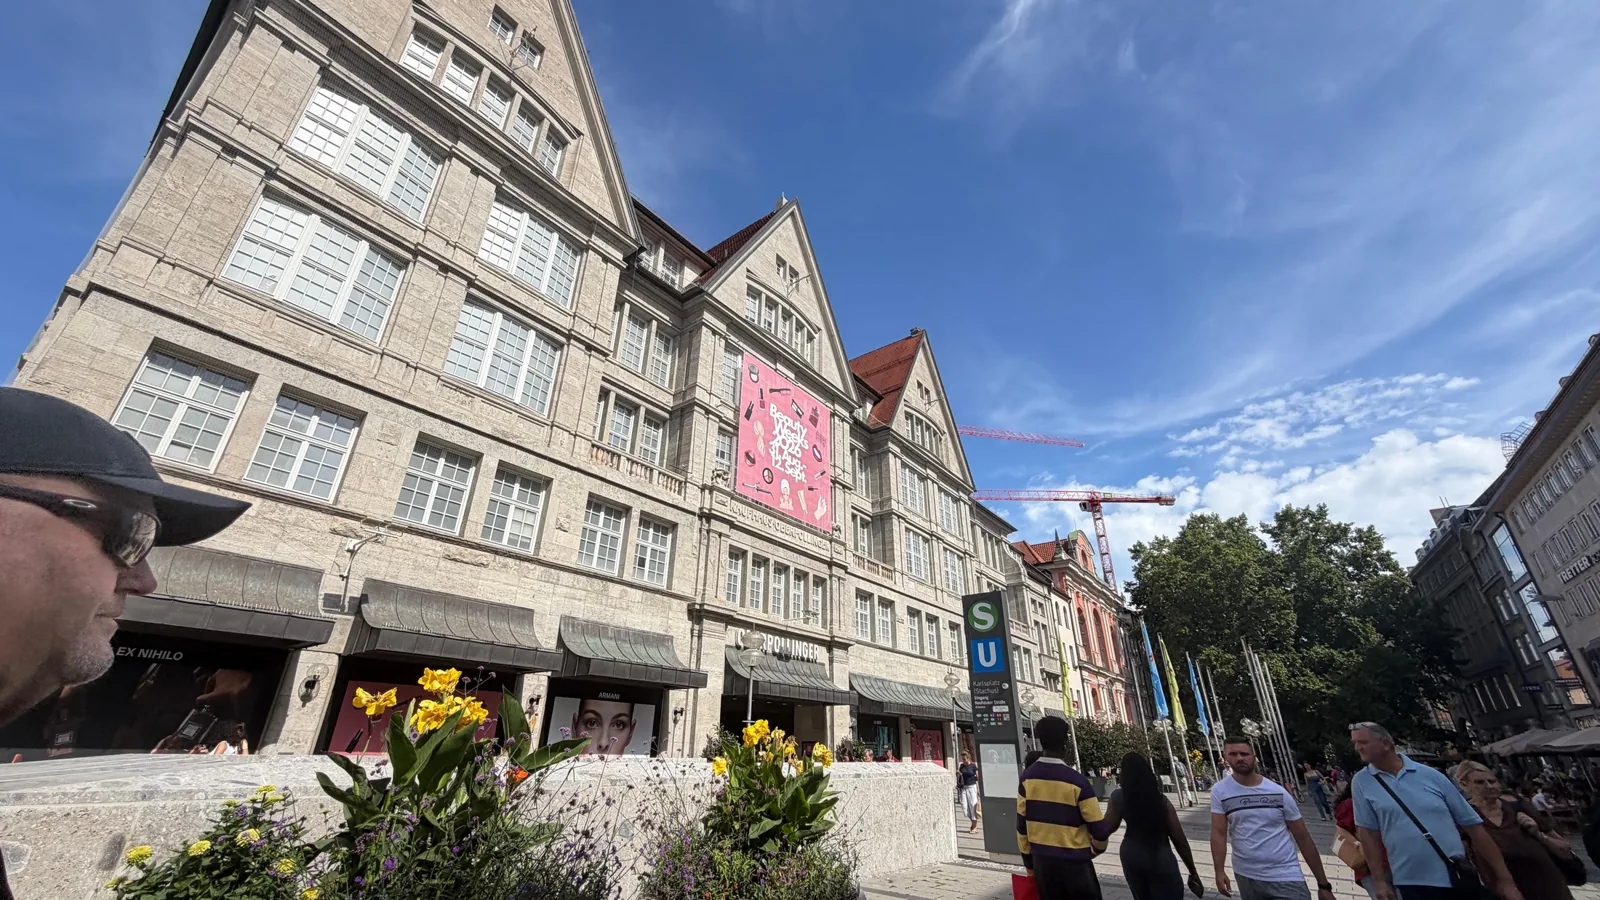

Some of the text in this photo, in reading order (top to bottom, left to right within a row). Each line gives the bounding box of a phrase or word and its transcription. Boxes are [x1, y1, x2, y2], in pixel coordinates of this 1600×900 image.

[769, 402, 808, 440] Beauty
[774, 416, 809, 450] Weeks
[769, 430, 802, 458] 2026
[784, 460, 808, 483] Sept.
[1557, 555, 1591, 584] TRETTER
[972, 602, 995, 630] S
[116, 646, 184, 661] EX NIHILO
[977, 641, 997, 668] U
[598, 691, 621, 700] ARMANI
